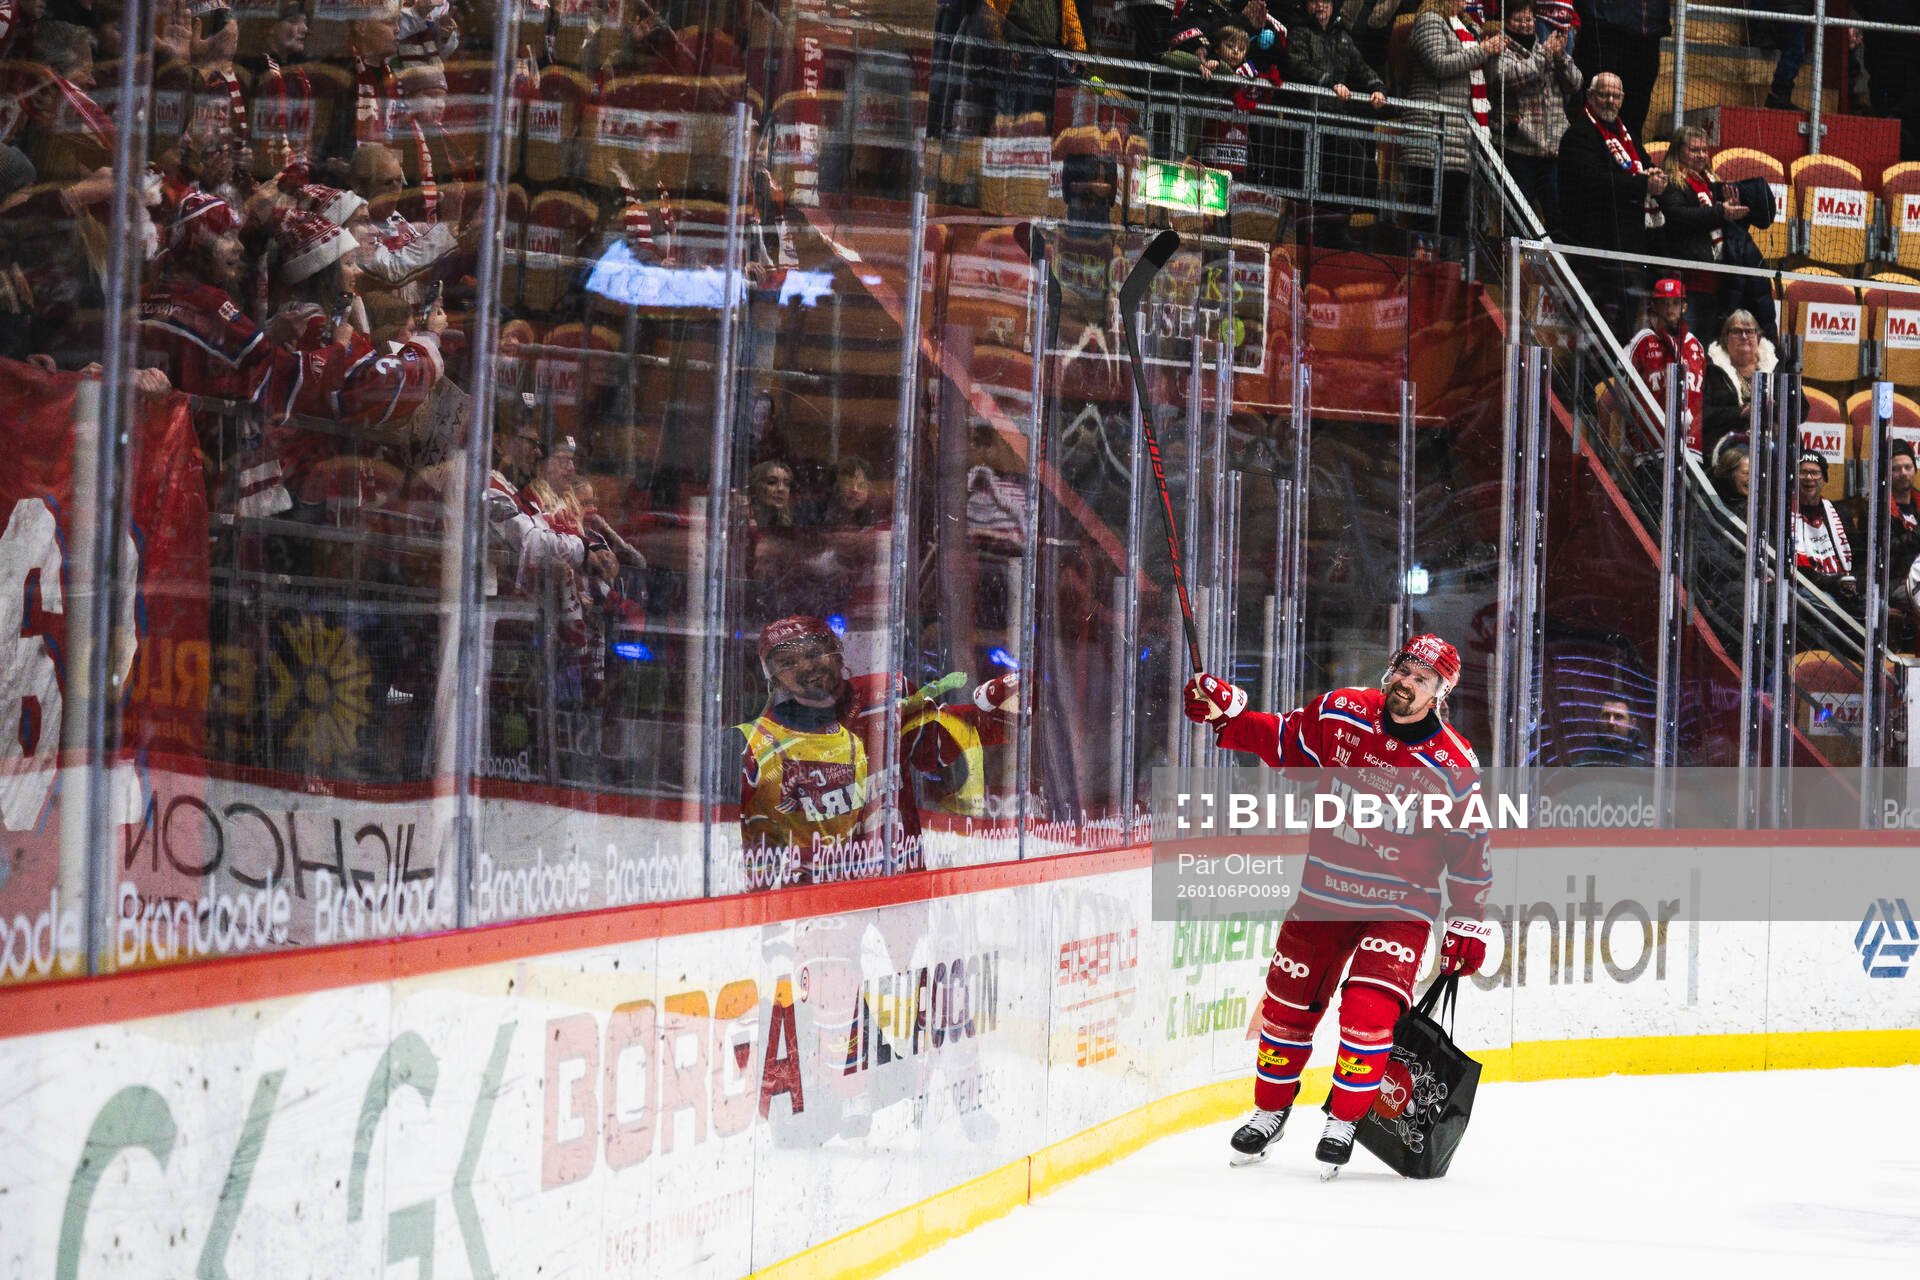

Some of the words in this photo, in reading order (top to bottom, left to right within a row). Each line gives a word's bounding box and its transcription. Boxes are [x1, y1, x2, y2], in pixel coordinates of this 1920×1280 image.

[1818, 197, 1862, 216] MAXI
[1811, 312, 1856, 331] MAXI
[1347, 701, 1368, 716] SCA
[1363, 751, 1399, 776] HIGHCON
[1446, 757, 1463, 780] SCA
[1540, 796, 1655, 828] Brandcode
[478, 847, 592, 922] Brandcode
[117, 867, 291, 967] Brandcode
[541, 973, 805, 1193] BORGA
